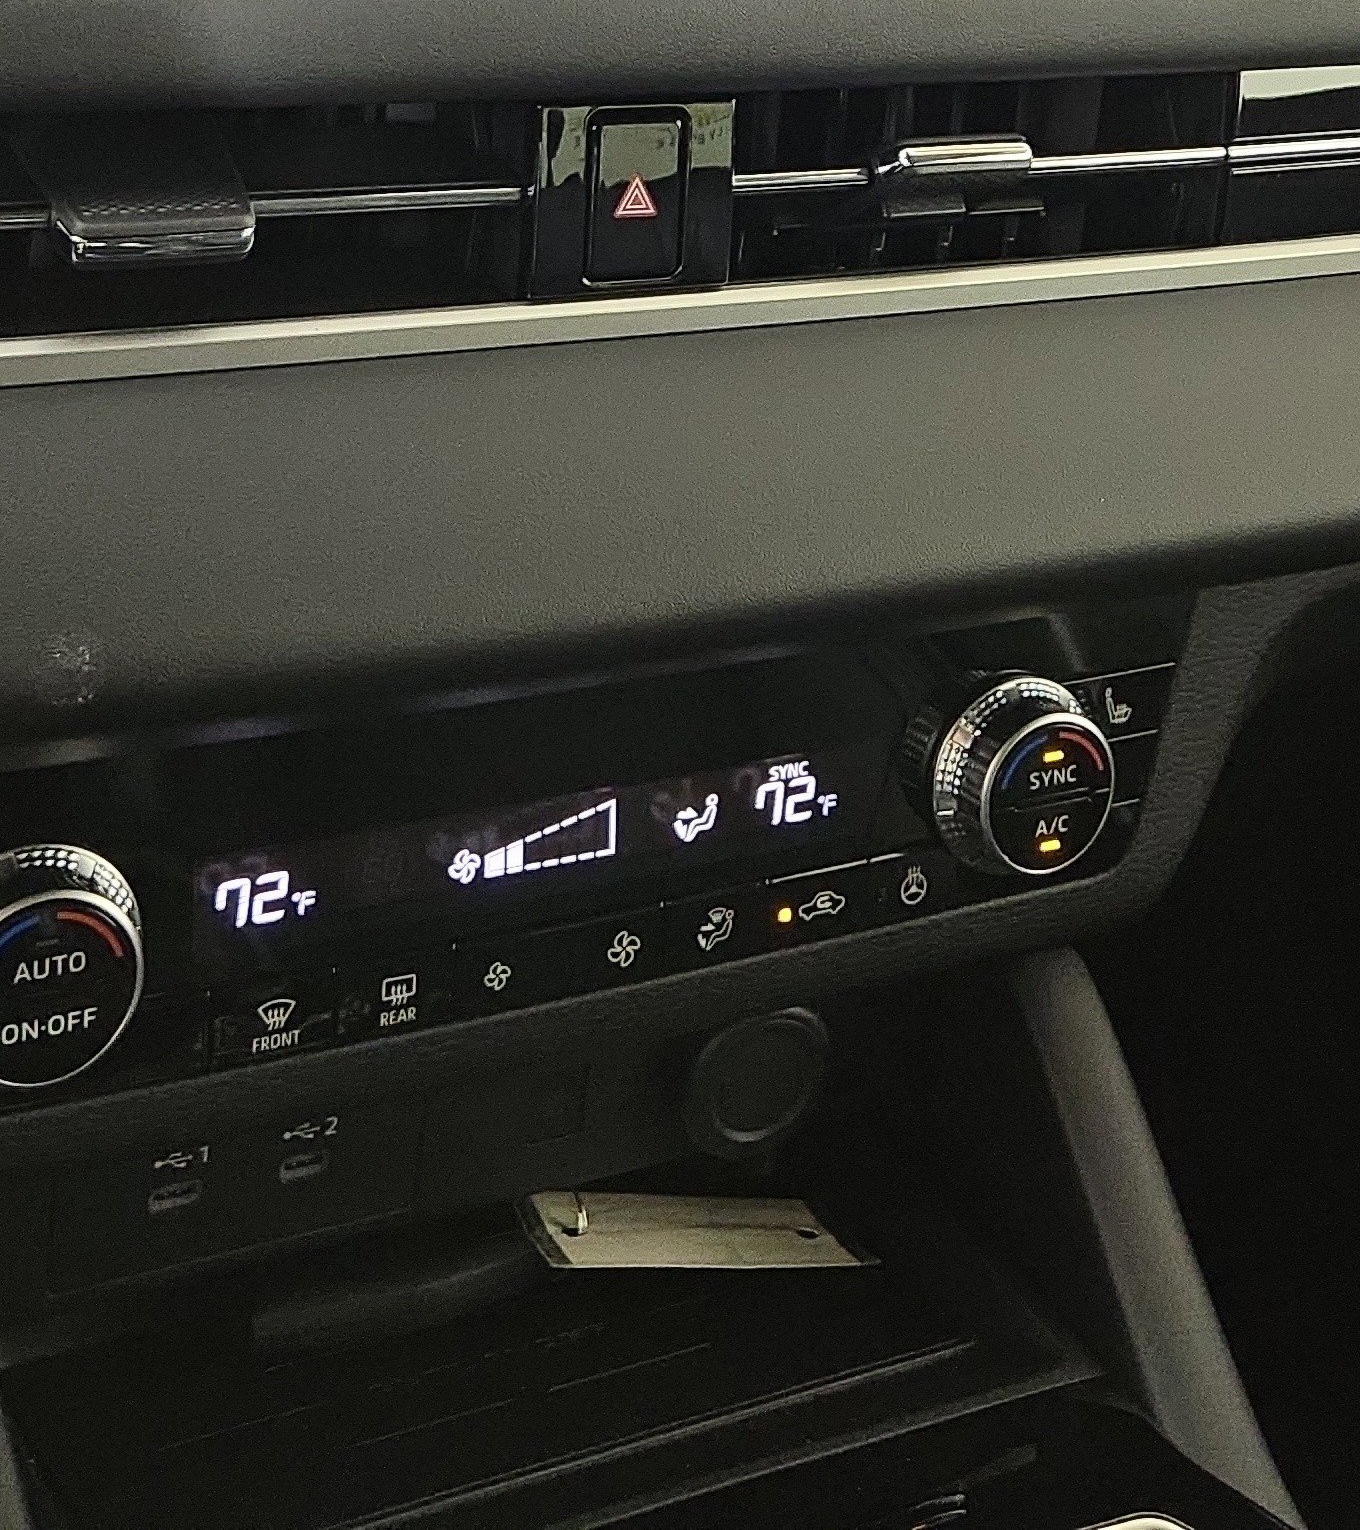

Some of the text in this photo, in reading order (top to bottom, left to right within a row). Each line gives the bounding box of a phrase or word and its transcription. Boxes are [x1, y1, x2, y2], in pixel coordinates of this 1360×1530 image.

[767, 760, 810, 782] SYNC
[1028, 764, 1077, 791] SYNC
[1035, 814, 1069, 838] A/C
[12, 950, 87, 985] AUTO
[379, 1006, 417, 1027] REAR
[251, 1029, 301, 1054] FRONT
[324, 1115, 339, 1136] 2
